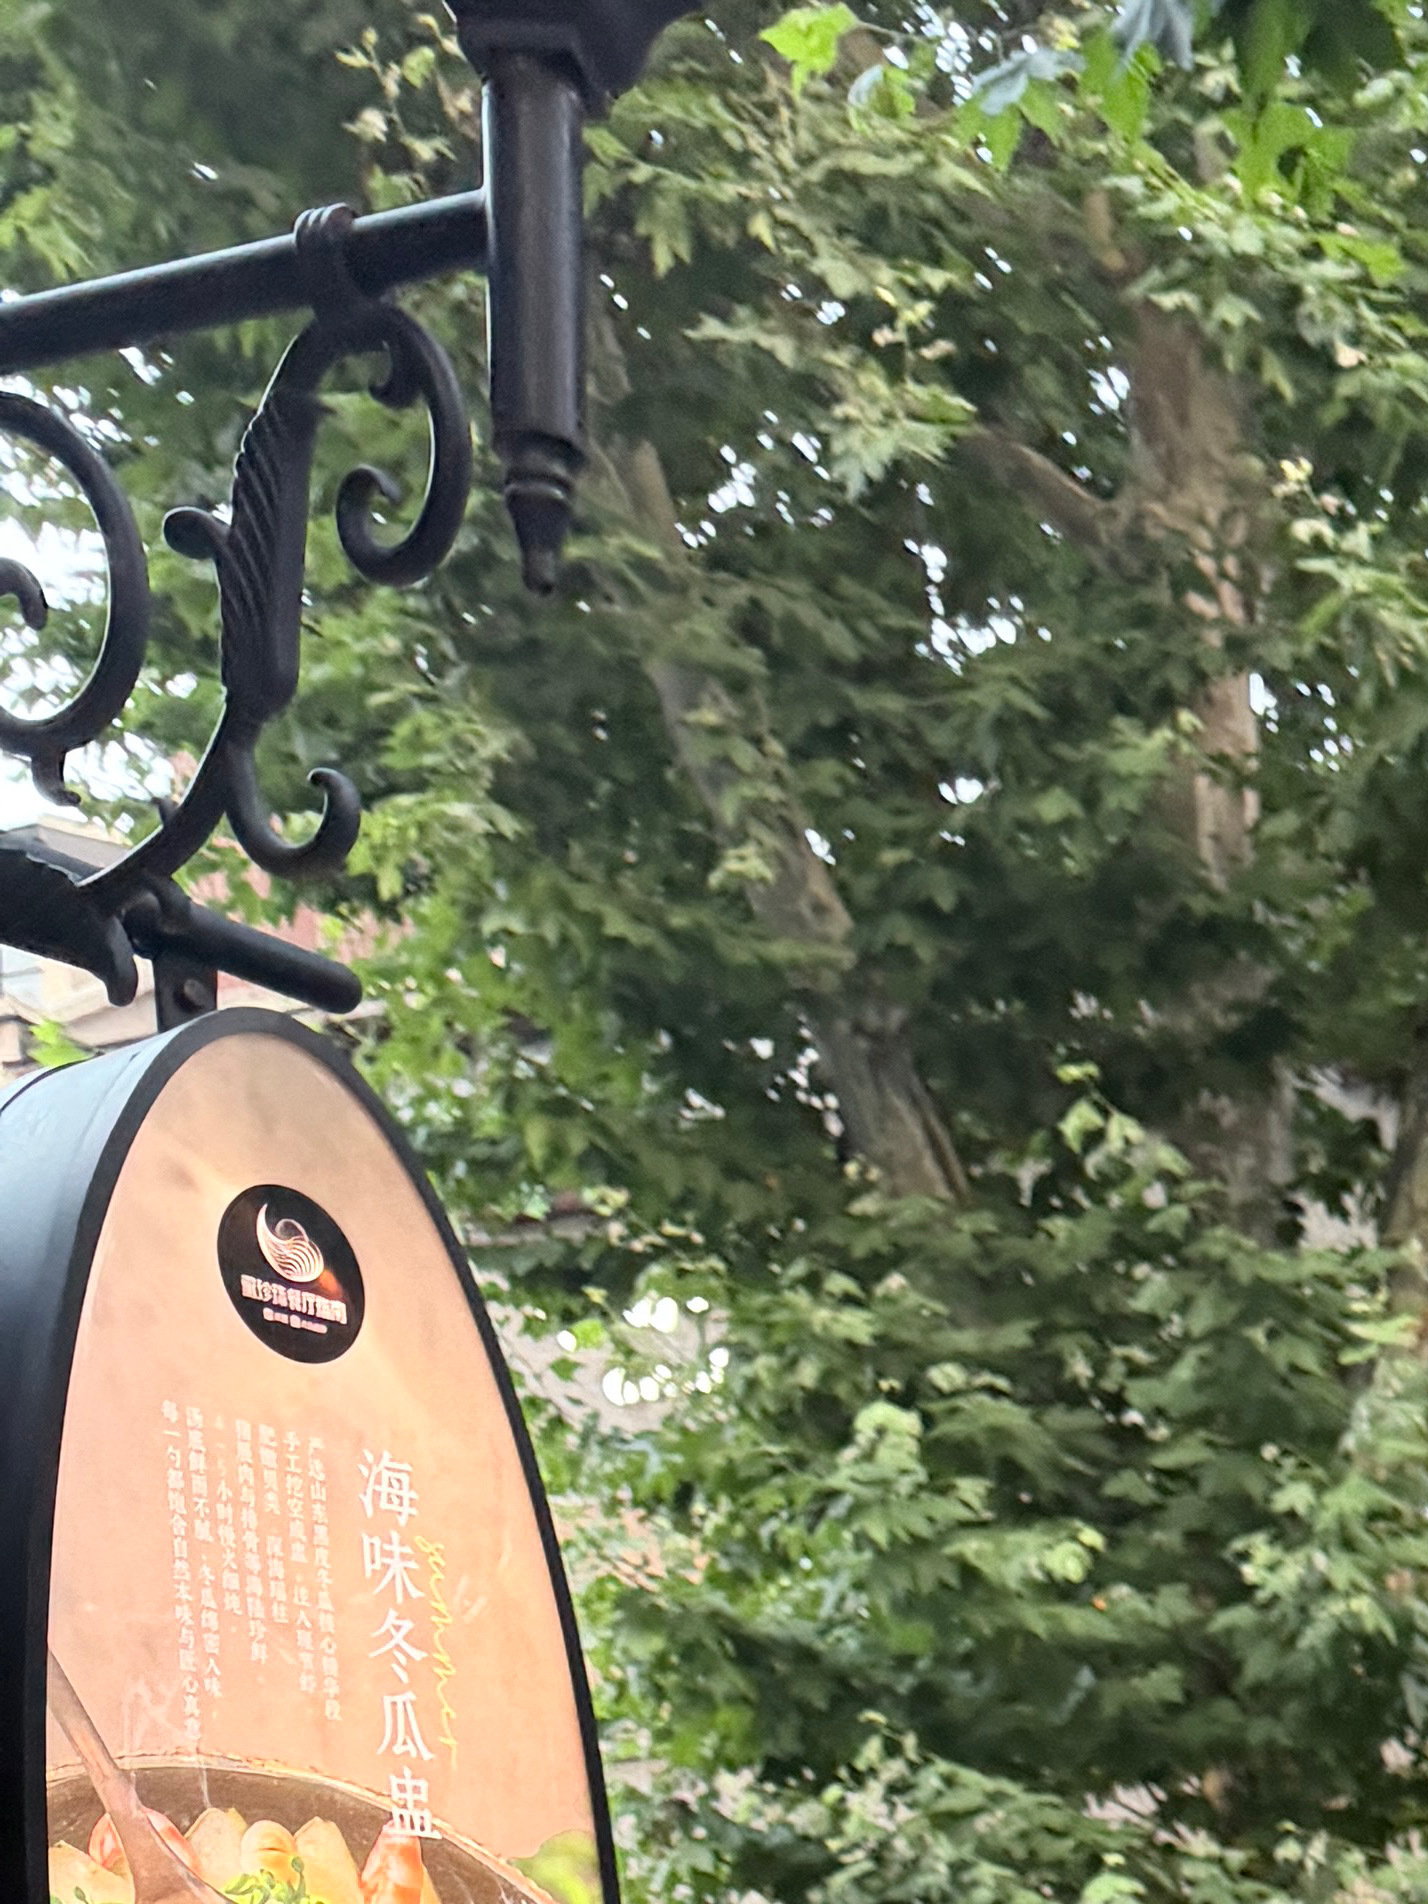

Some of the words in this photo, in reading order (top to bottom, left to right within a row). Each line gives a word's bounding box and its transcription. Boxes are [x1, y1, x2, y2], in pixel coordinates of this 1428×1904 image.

[357, 1449, 443, 1840] 海味冬瓜盅
